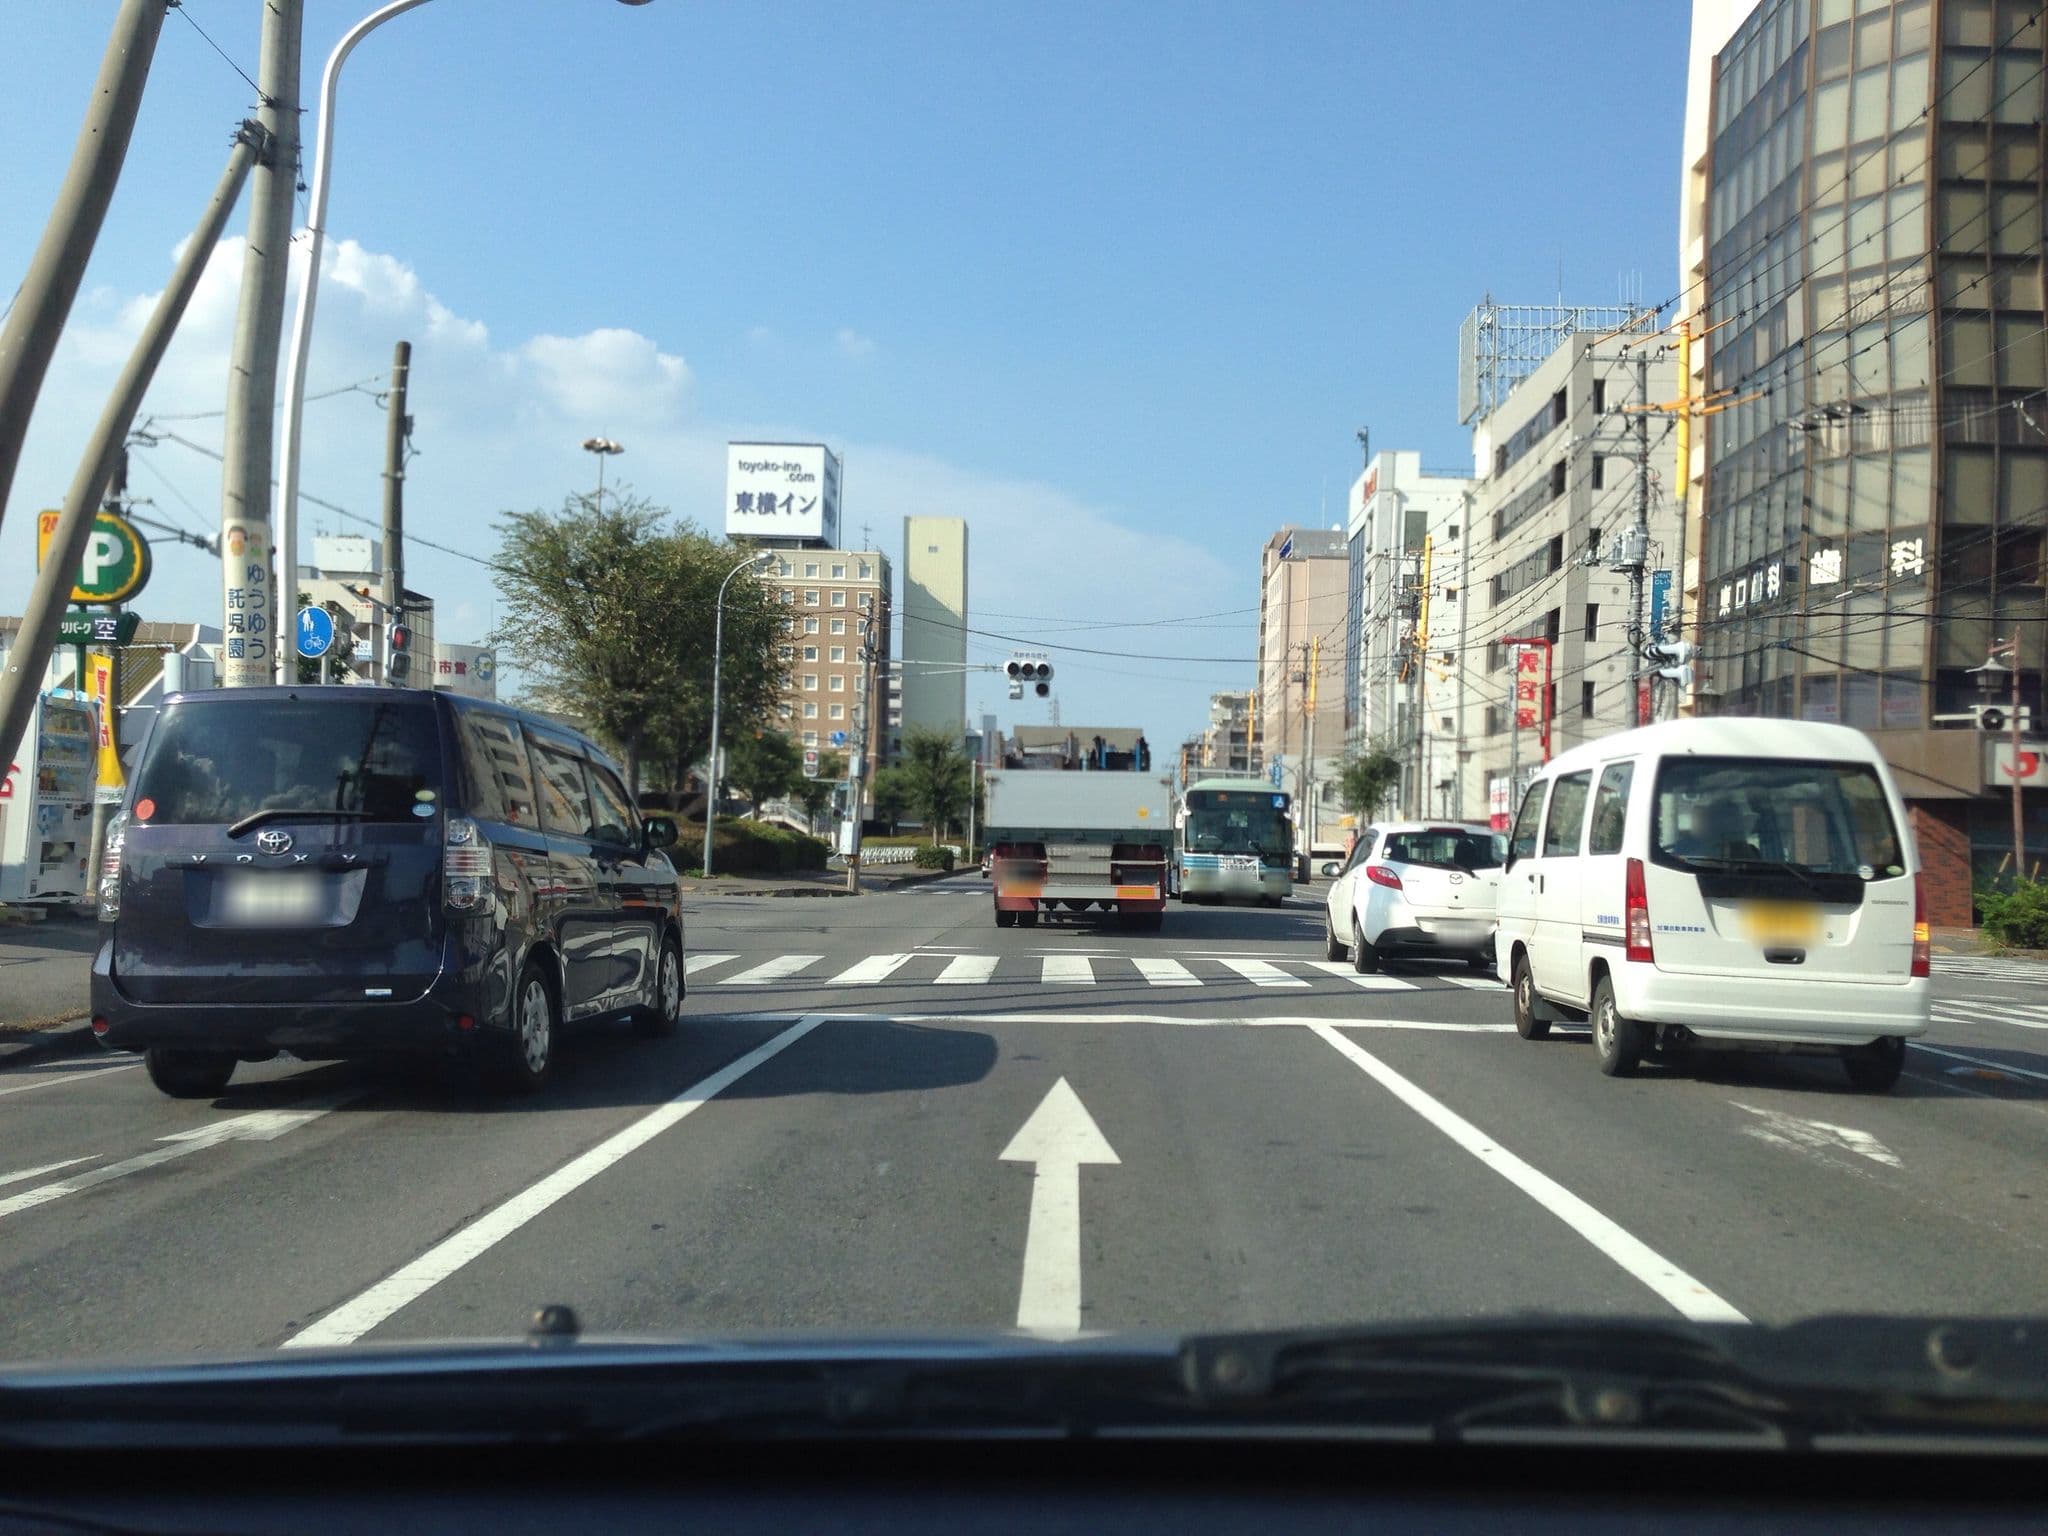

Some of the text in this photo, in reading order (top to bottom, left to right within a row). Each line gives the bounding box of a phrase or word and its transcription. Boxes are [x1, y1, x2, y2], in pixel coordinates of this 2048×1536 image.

[738, 459, 802, 474] toyoko-inn
[785, 472, 816, 482] .com
[734, 491, 817, 515] 東横イン
[82, 531, 124, 585] P
[247, 563, 266, 660] ゆうゆう
[94, 618, 118, 640] 空
[228, 588, 245, 659] 託児園
[191, 854, 357, 864] VOXY
